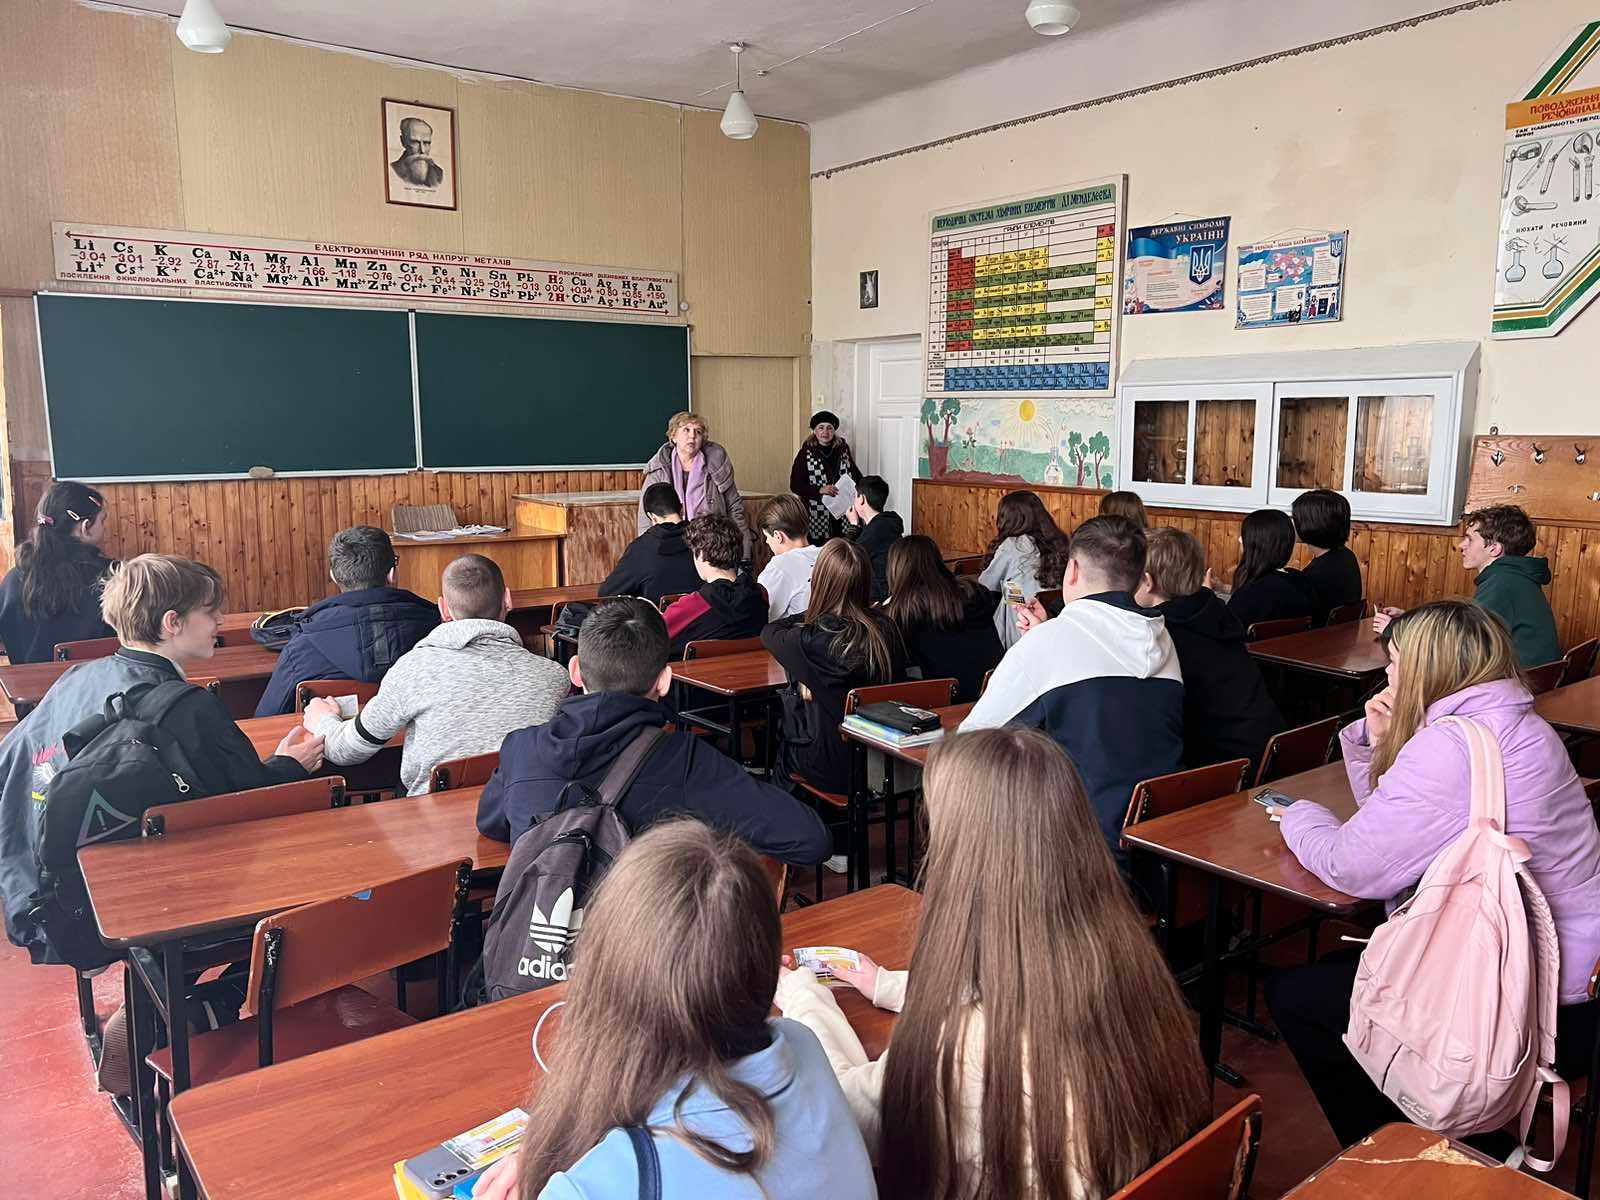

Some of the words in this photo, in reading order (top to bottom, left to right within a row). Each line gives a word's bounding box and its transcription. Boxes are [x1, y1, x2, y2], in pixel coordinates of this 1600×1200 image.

[1550, 219, 1587, 229] РЕЧОВИНИ
[1176, 230, 1224, 244] УКРАЇНИ
[74, 238, 95, 250] Li
[113, 241, 134, 253] Cs
[154, 244, 168, 256] K
[192, 248, 212, 258] Ca
[228, 250, 250, 262] Na
[264, 252, 288, 265] Mg
[300, 256, 320, 266] Al
[334, 258, 358, 268] Mn
[366, 260, 387, 271] Zn
[400, 263, 418, 274] Cr
[432, 266, 448, 276] Fe
[488, 270, 508, 280] Sn
[516, 272, 534, 282] Pb
[572, 276, 587, 286] Cu
[596, 279, 612, 289] Ag
[622, 280, 638, 291] Hg
[647, 282, 662, 292] Au
[409, 251, 430, 260] РЯД
[432, 253, 470, 262] НАПРУГ
[474, 256, 511, 266] МЕТАЛІВ
[60, 272, 110, 280] ПОСИЛЕННЯ
